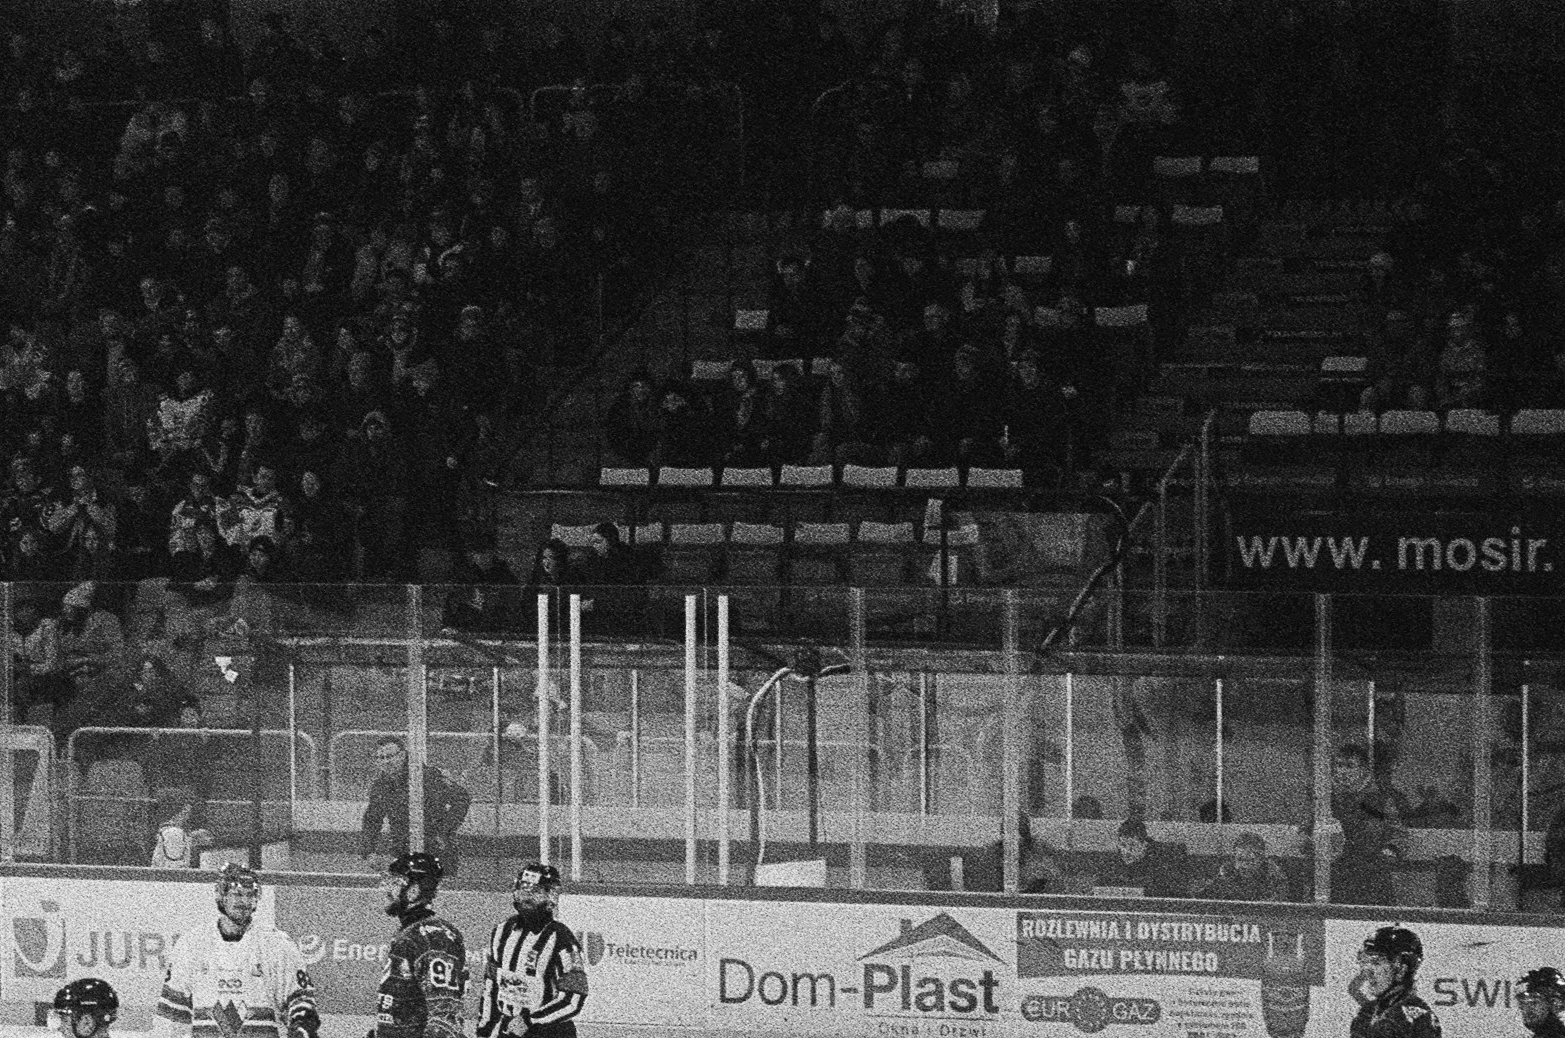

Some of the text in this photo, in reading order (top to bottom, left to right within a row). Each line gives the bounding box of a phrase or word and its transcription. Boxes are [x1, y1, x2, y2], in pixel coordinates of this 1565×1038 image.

[1022, 919, 1261, 943] ROZLEWNIA I DYSTRYBUCJA
[607, 943, 698, 961] Teletecnica
[1063, 949, 1219, 972] GAZU PŁYNNEGO
[719, 957, 999, 1014] Dom-Plast
[1434, 977, 1512, 1008] SWI
[1112, 1001, 1156, 1021] GAZ
